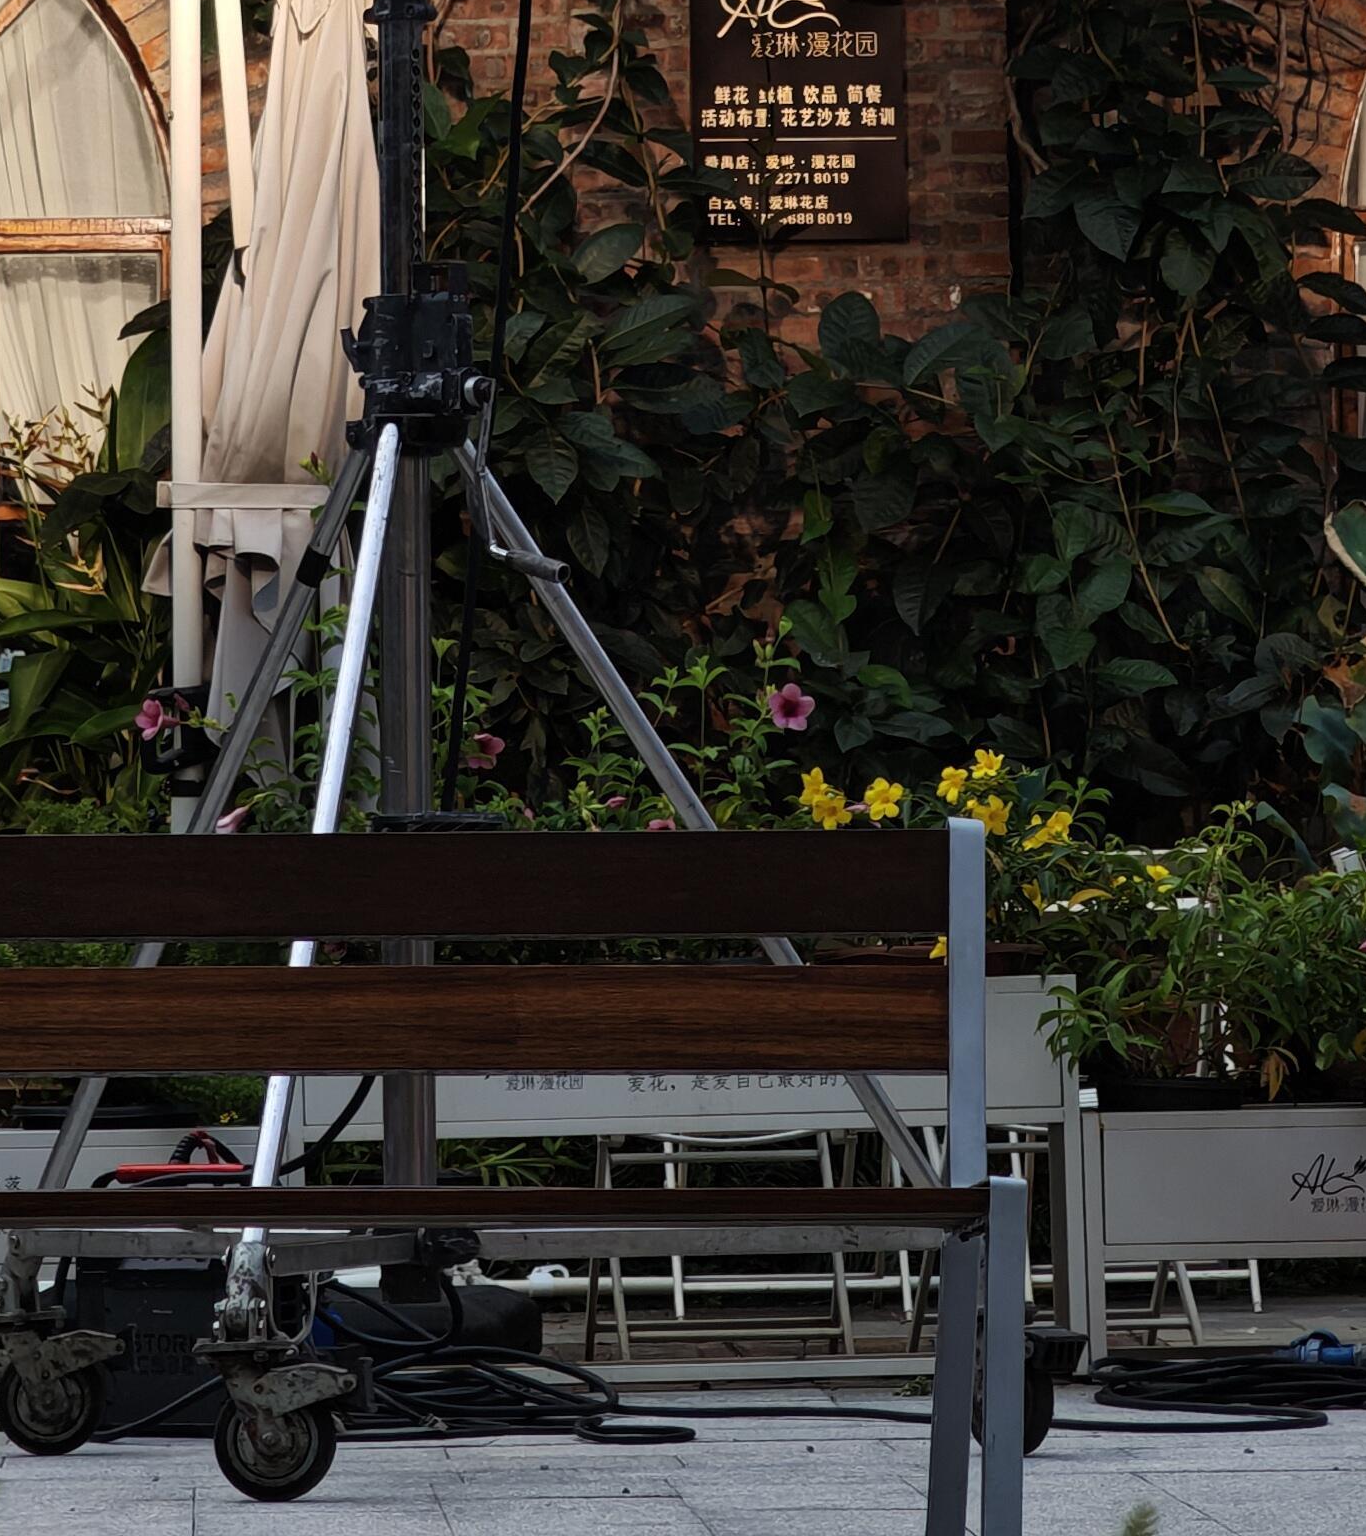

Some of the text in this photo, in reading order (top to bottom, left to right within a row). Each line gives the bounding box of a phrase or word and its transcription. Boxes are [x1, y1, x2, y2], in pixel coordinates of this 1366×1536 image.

[714, 85, 750, 105] 鲜花
[803, 84, 838, 105] 饮品
[846, 84, 882, 105] 简餐
[701, 106, 895, 128] 活动布置 花艺沙龙 培训
[813, 172, 849, 184] 8019
[768, 195, 829, 210] 爱琳花店
[134, 1332, 192, 1354] STOR
